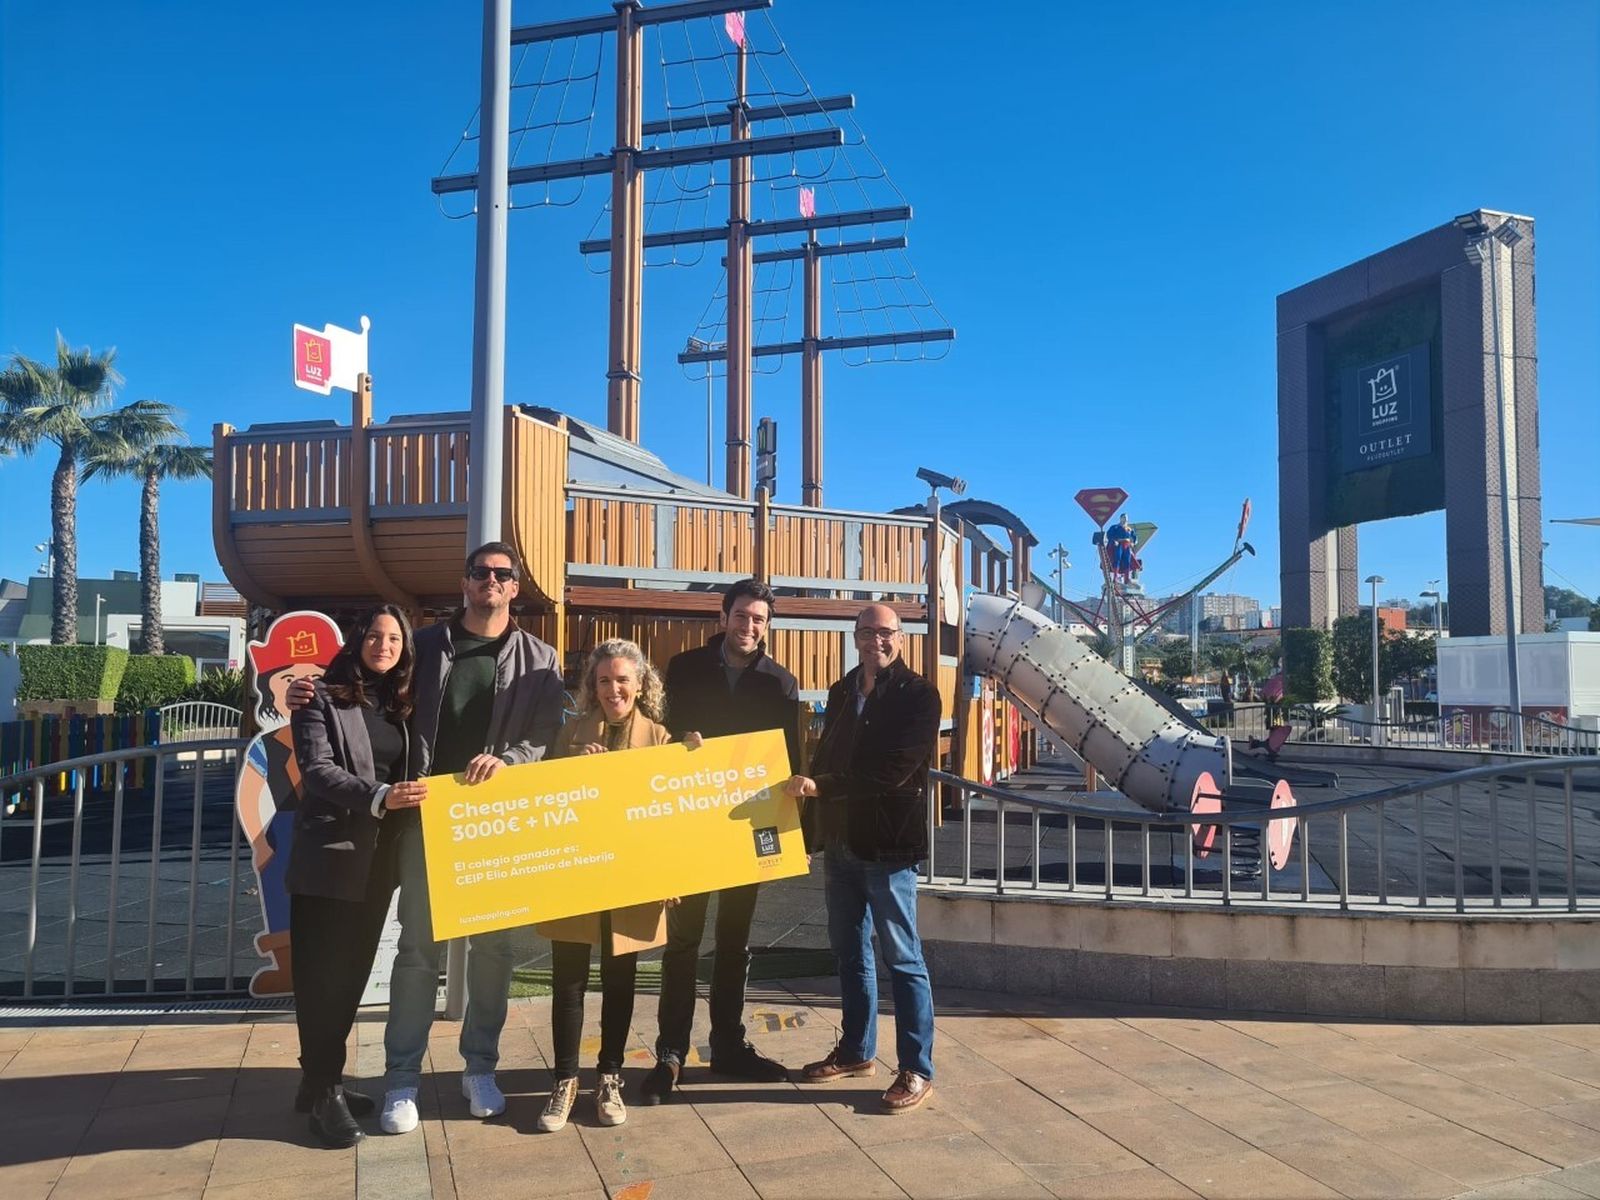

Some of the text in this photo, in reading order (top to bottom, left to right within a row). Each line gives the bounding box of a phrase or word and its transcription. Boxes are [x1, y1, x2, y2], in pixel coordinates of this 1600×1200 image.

[305, 364, 323, 377] LUZ
[1372, 402, 1397, 419] LUZ
[1360, 433, 1412, 454] OUTLET
[651, 764, 767, 793] Contigo es
[449, 784, 600, 820] Cheque regalo
[626, 783, 771, 821] más Navidad
[452, 808, 579, 841] 3000€ + IVA
[454, 843, 579, 871] El colegio ganador es:
[456, 851, 615, 885] CEIP Elio Antonio de Nebrija
[459, 906, 529, 925] luzshopping.com
